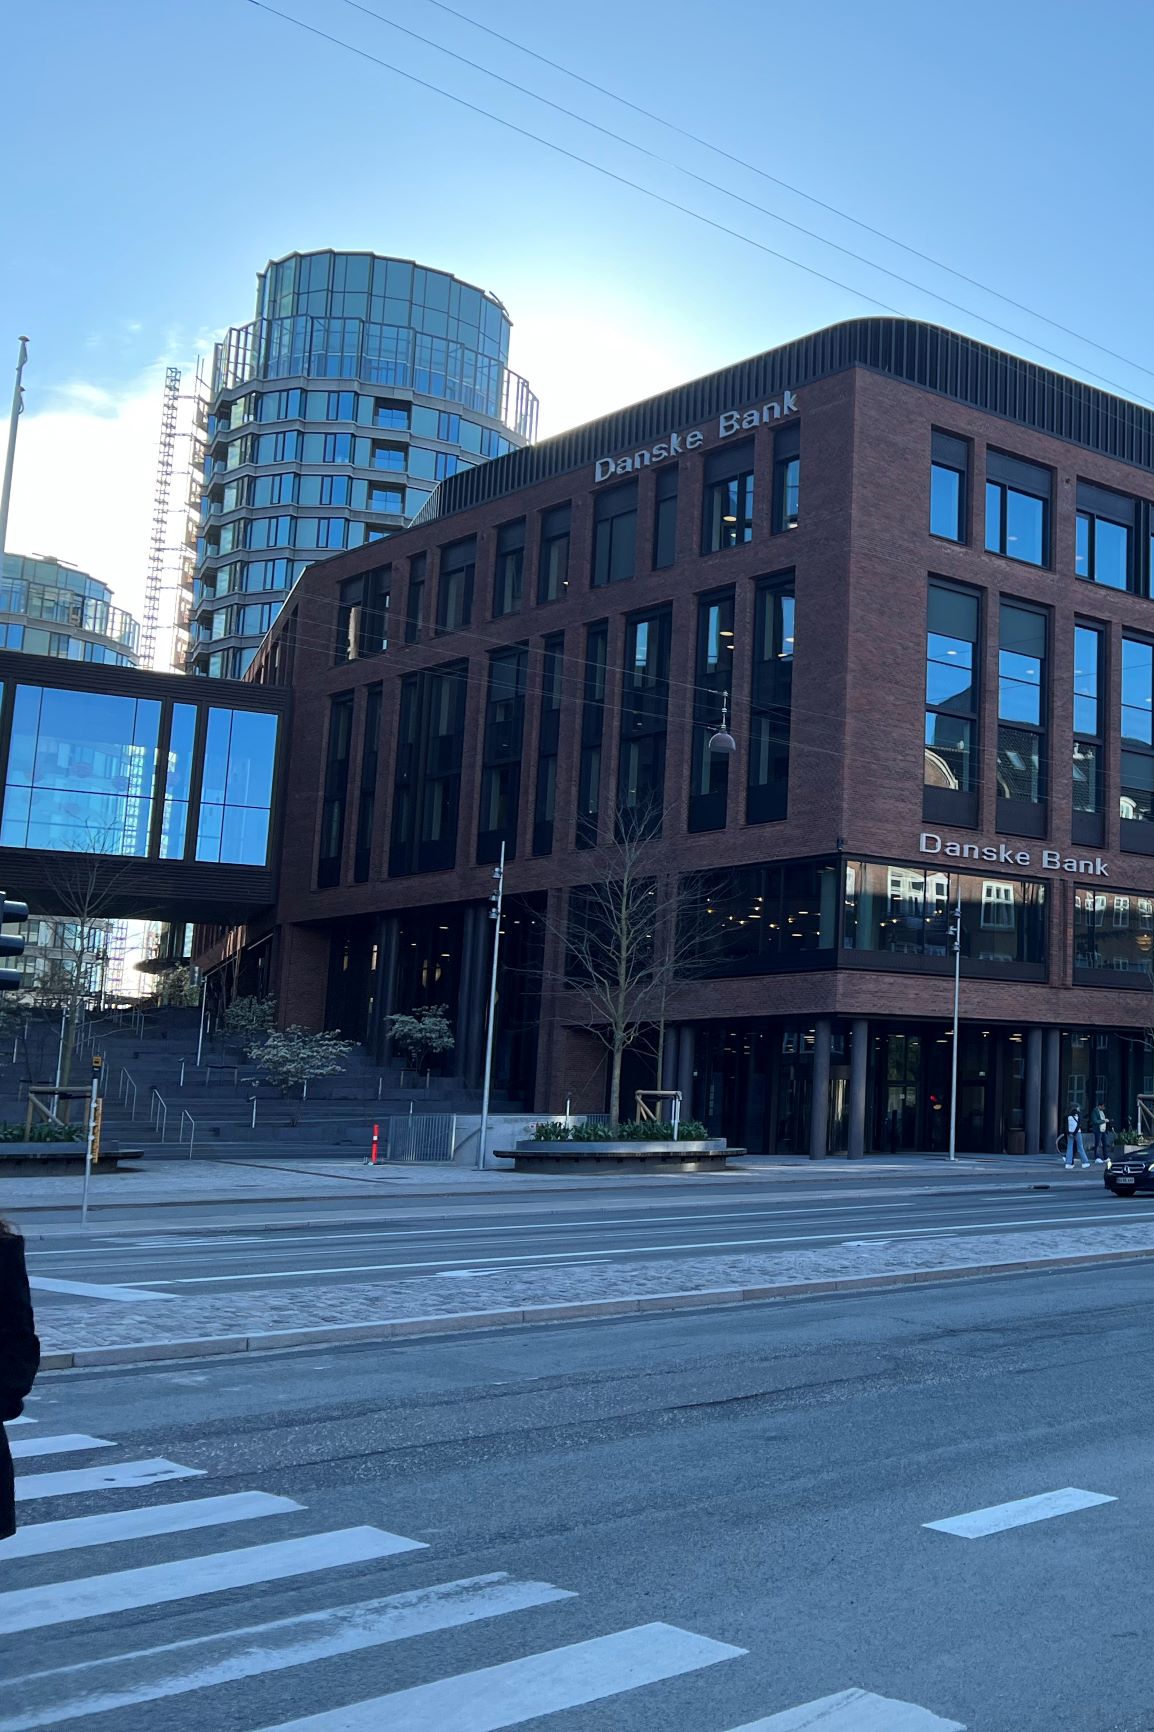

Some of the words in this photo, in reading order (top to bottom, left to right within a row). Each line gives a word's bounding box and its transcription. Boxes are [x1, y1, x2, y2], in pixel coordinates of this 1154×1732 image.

[594, 430, 704, 482] Danske
[719, 390, 799, 438] Bank
[919, 832, 1030, 866] Danske
[1042, 850, 1109, 876] Bank
